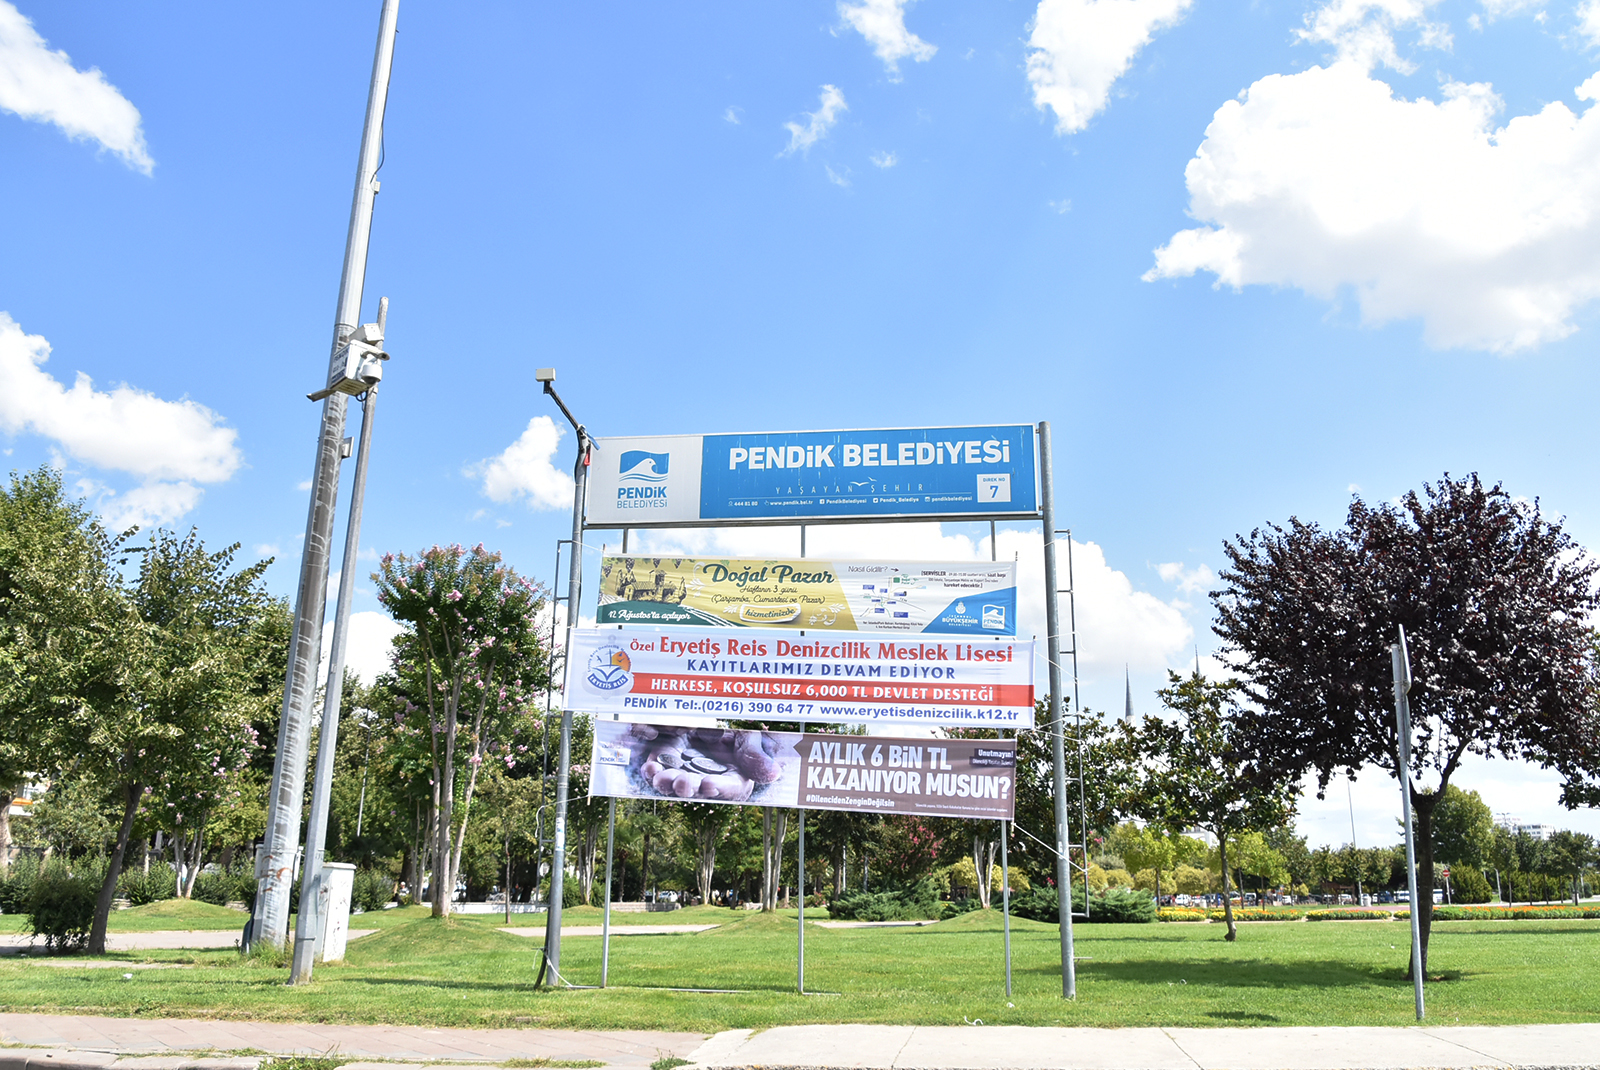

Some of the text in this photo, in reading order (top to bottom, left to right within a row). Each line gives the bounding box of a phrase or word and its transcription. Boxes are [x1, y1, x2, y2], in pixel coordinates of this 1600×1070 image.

[776, 483, 923, 495] YAŞAYAN ŞEHİR
[989, 485, 999, 499] 7
[702, 563, 835, 588] Doğal Pazar
[740, 585, 798, 595] Haftanın 3 günü
[608, 610, 617, 618] 12
[745, 608, 795, 618] hizmetinizde
[630, 636, 1013, 662] Özel Eryetiş Reis Denizcilik Meslek Lisesi
[687, 659, 956, 679] KAYITLARIMIZ DEVAM EDİYOR
[651, 678, 994, 702] HERKESE, KOŞULSUZ 6,000 TL DEVLET DESTEĞİ
[624, 695, 668, 709] PENDİK
[748, 701, 772, 712] 390
[777, 702, 793, 714] 64
[798, 704, 814, 715] 77
[820, 706, 1019, 721] www.eryetisdenizcilik.k12.tr
[808, 741, 867, 766] AYLIK
[871, 744, 883, 767] 6
[927, 747, 952, 770] TL
[806, 766, 1011, 799] KAZANIYOR MUSUN?
[806, 794, 895, 808] #DilencidenZenginDeğilsin
